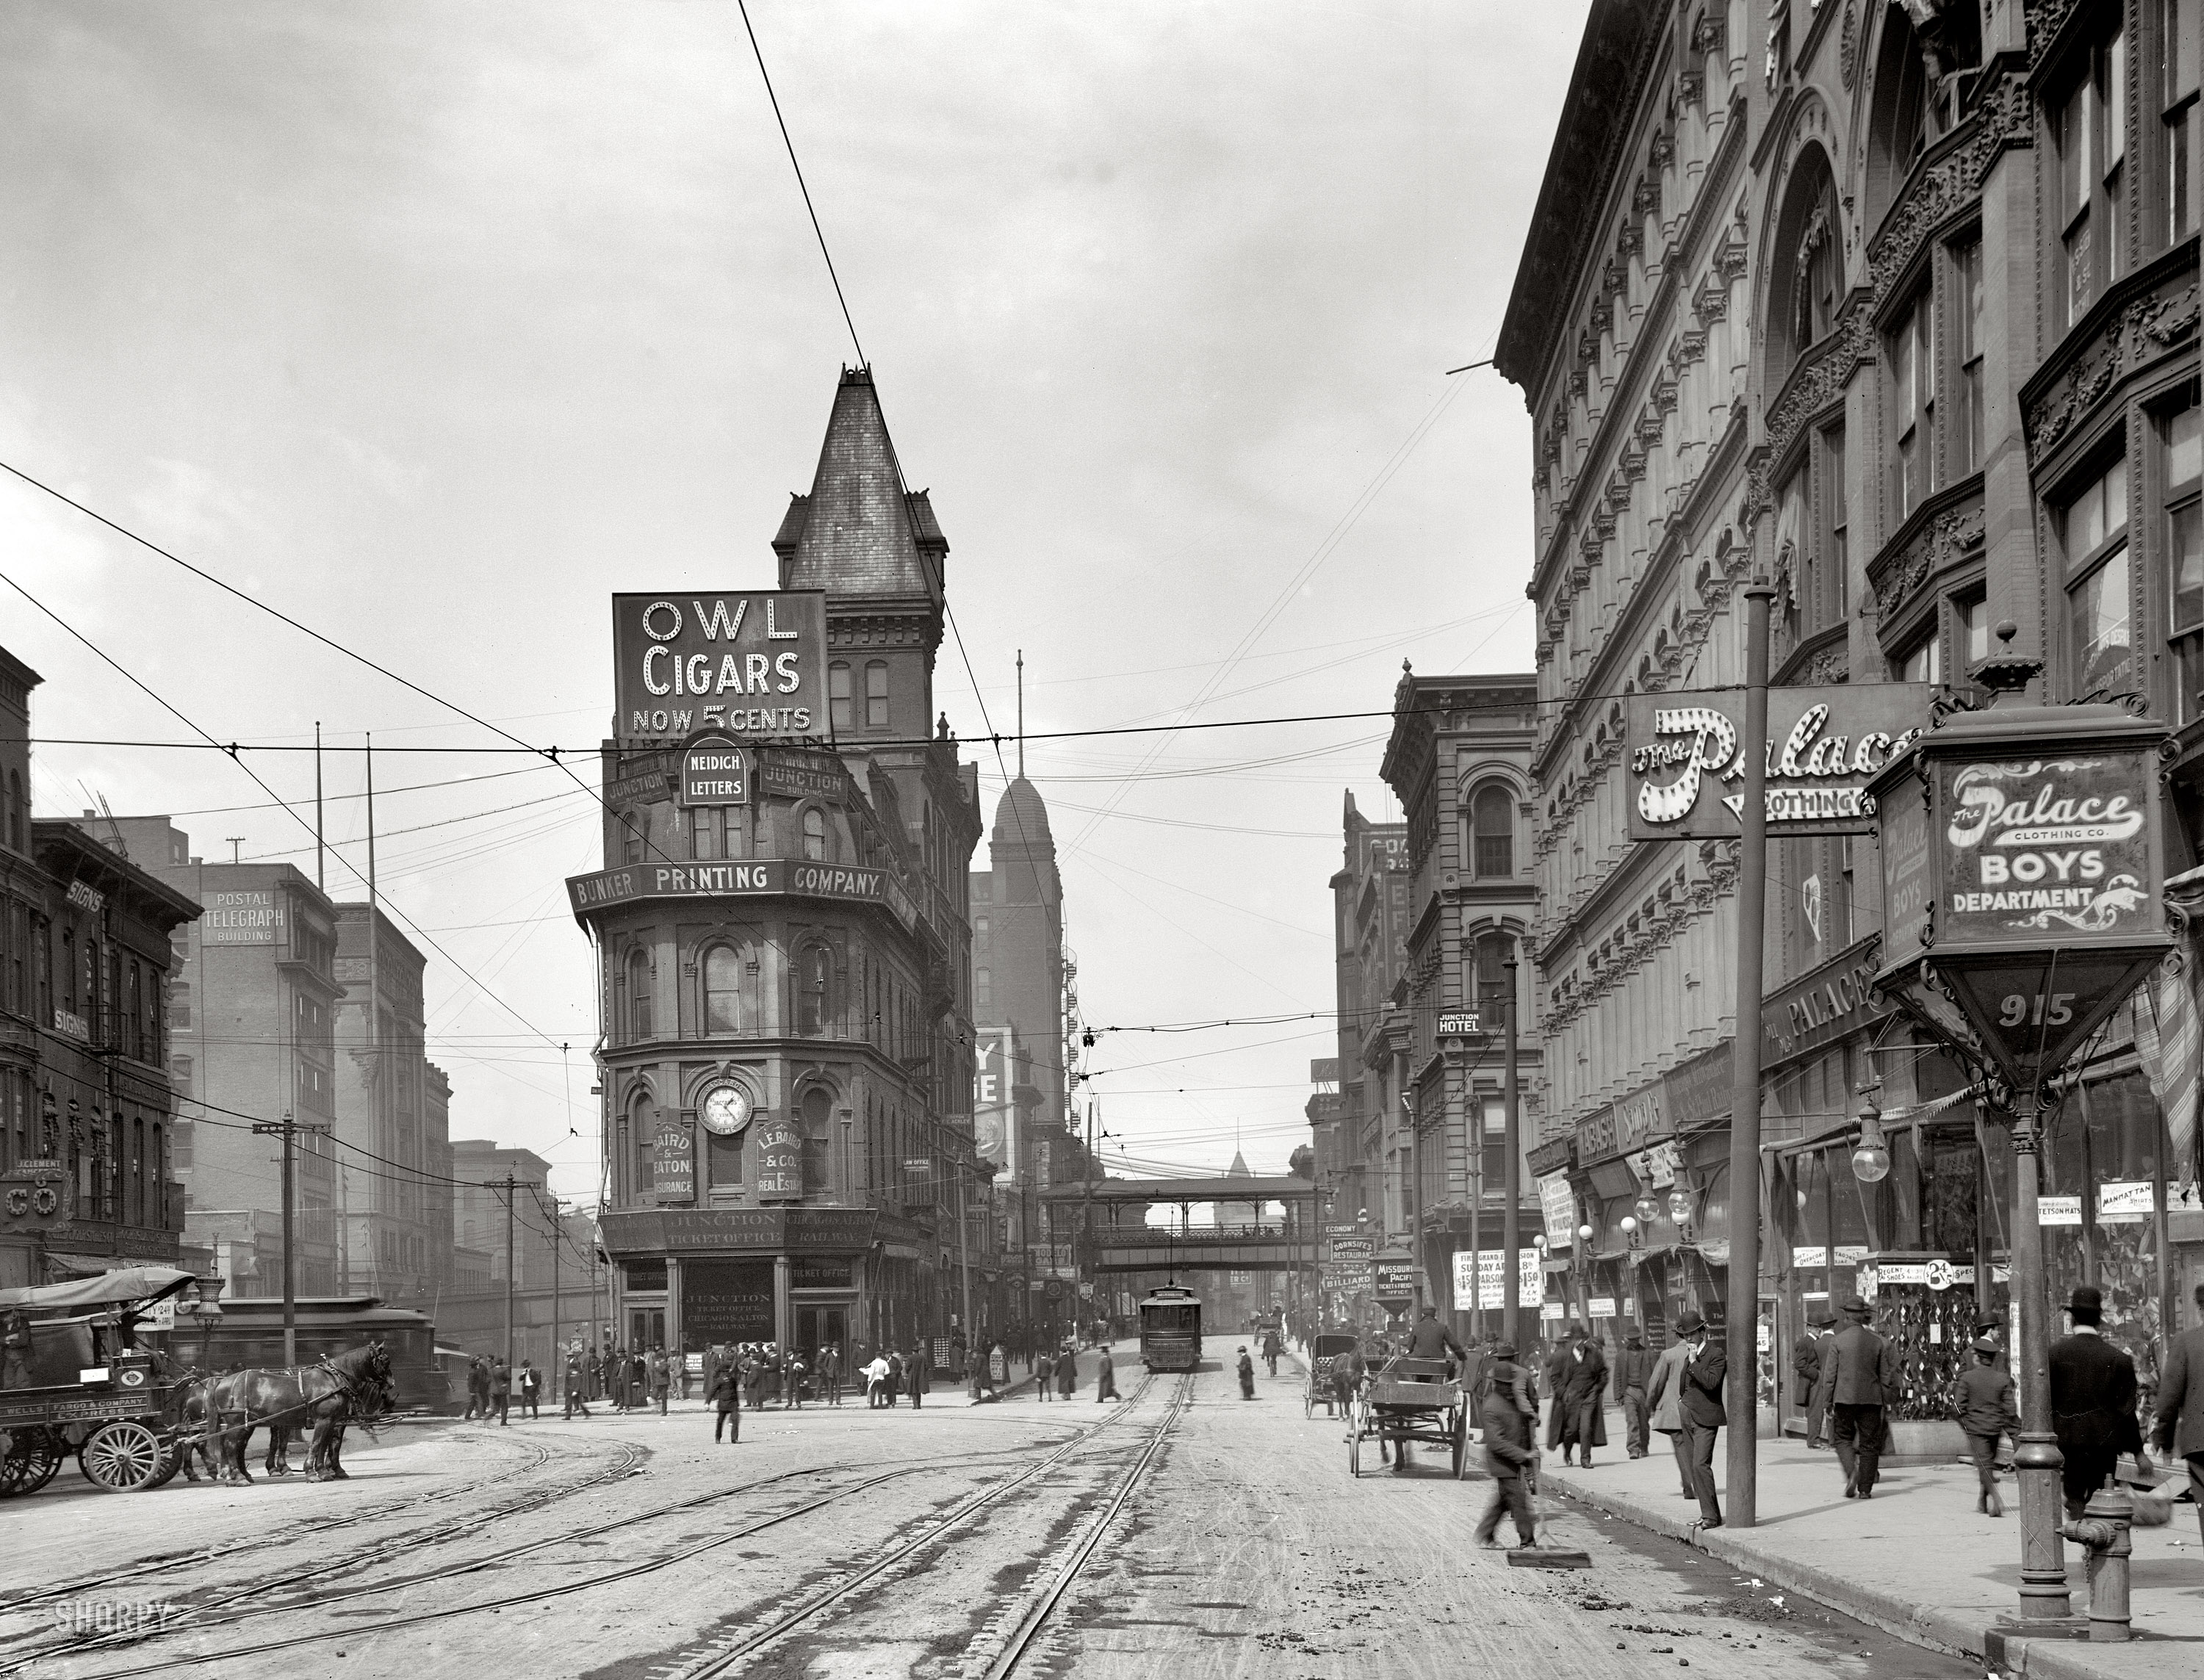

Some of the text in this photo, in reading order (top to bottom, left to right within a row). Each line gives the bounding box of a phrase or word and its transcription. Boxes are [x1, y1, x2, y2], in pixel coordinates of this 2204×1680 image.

[643, 599, 798, 641] OWL
[643, 645, 800, 695] CIGARS
[633, 705, 810, 731] NOW 5 CENTS
[691, 755, 740, 771] NEIDICH
[610, 773, 663, 799] JUNCTION
[765, 766, 842, 791] JUNCTION
[691, 780, 742, 796] LETTERS
[1948, 782, 2131, 848] Palace
[1951, 808, 1981, 823] The
[2014, 829, 2110, 840] CLOTHING CO.
[1980, 850, 2105, 884] BOYS
[576, 866, 880, 905] BUNKER PRINTING COMPANY.
[66, 881, 104, 913] SIGNS
[217, 893, 270, 906] POSTAL
[1893, 879, 1921, 918] BOYS
[1953, 887, 2094, 913] DEPARTMENT
[204, 909, 284, 927] TELEGRAPH
[217, 931, 272, 941] BUILDING
[1787, 970, 1869, 1037] PALACE
[1998, 992, 2076, 1028] 915
[54, 1009, 90, 1041] SIGNS
[1439, 1020, 1480, 1033] HOTEL
[652, 1133, 690, 1153] BAIRD
[664, 1148, 672, 1158] &
[766, 1155, 797, 1167] & CO.
[759, 1180, 777, 1191] REAL
[2103, 1184, 2151, 1208] MANHATTAN
[669, 1214, 776, 1227] JUNCTION
[667, 1233, 721, 1244] TICKET
[1334, 1240, 1373, 1251] DORNSIFE'S
[1479, 1253, 1499, 1261] GRAND
[1793, 1253, 1805, 1261] SUIT
[1799, 1252, 1826, 1266] OVERCOAT
[793, 1269, 851, 1278] TICKET OFFICE
[1378, 1264, 1413, 1276] MISSOURI
[1461, 1263, 1494, 1272] SUDAY
[1390, 1273, 1412, 1283] PACIFI
[1887, 1273, 1905, 1281] SHOES
[686, 1294, 771, 1303] JUNCTION
[7, 1405, 44, 1415] WELLS
[54, 1402, 87, 1411] FARGO
[98, 1398, 143, 1408] COMPANY
